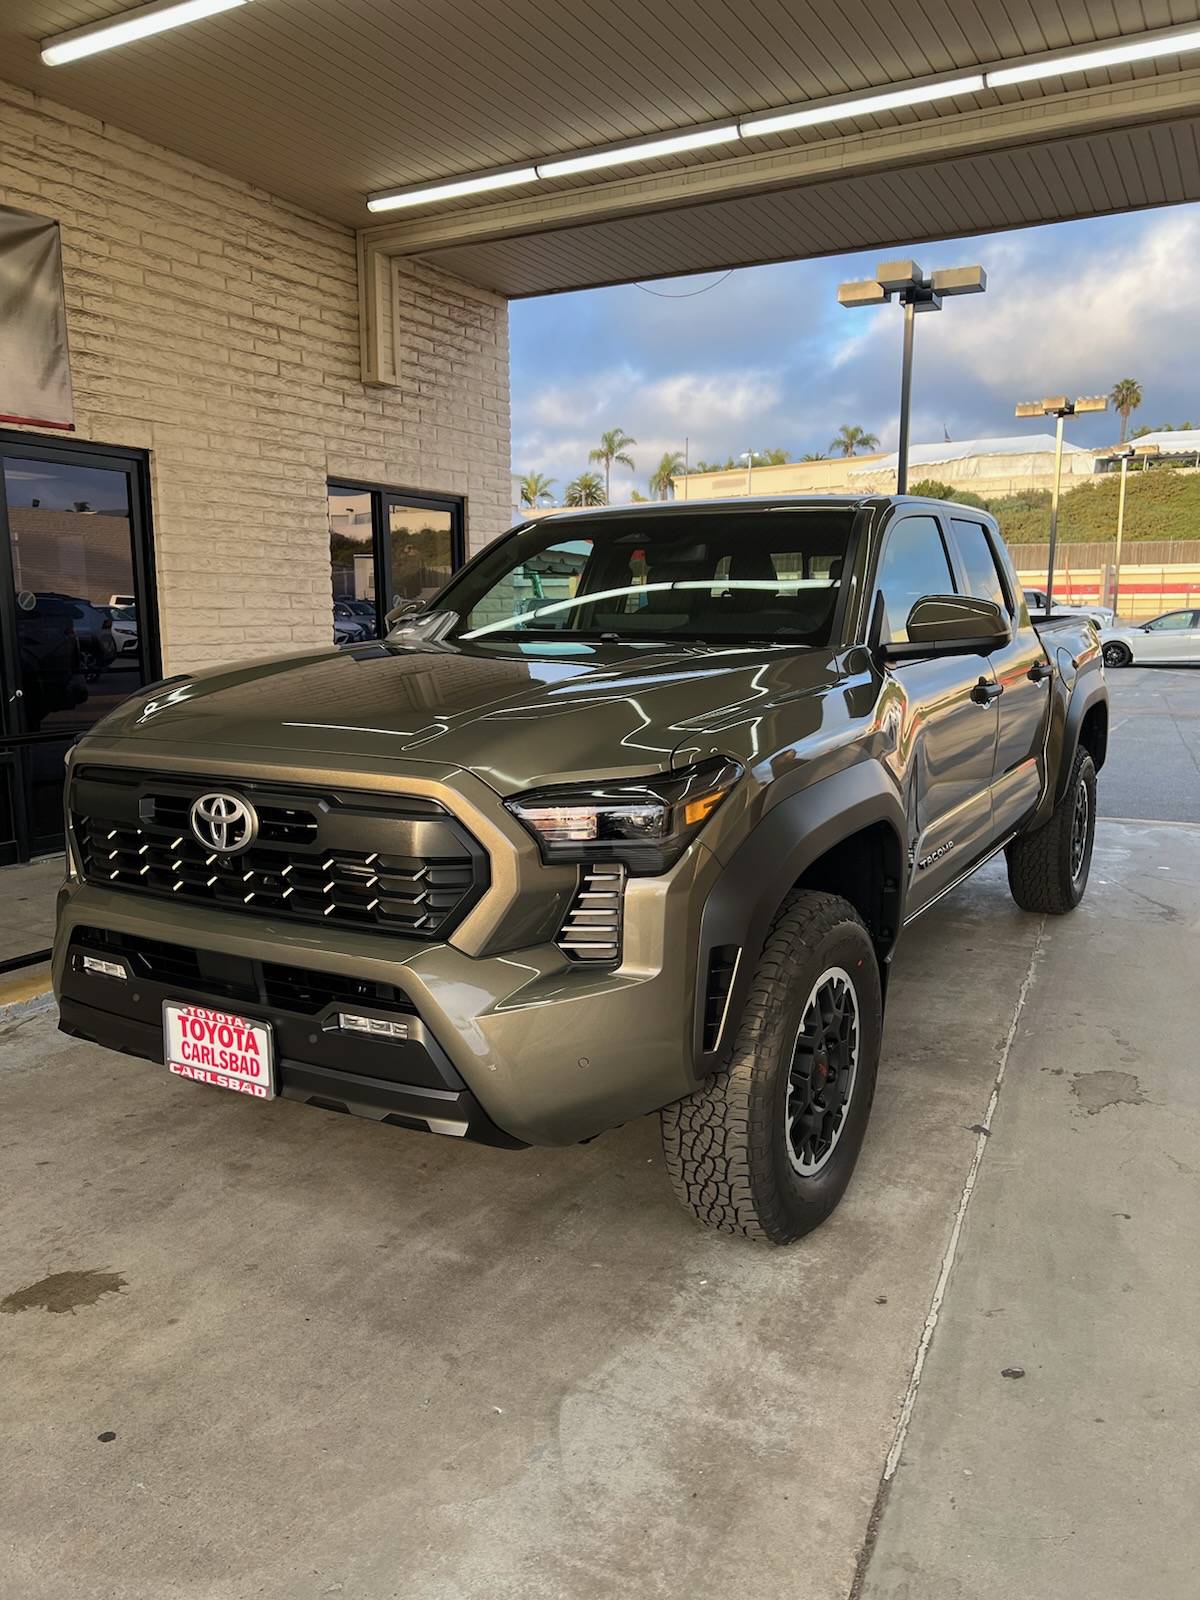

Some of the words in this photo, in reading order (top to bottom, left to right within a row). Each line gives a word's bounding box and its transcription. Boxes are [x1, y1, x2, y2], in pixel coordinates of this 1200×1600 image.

[188, 1007, 244, 1027] TOYOTA
[178, 1015, 260, 1056] TOYOTA
[182, 1041, 260, 1077] CARLSBAD
[169, 1062, 267, 1098] CARLSBAD
